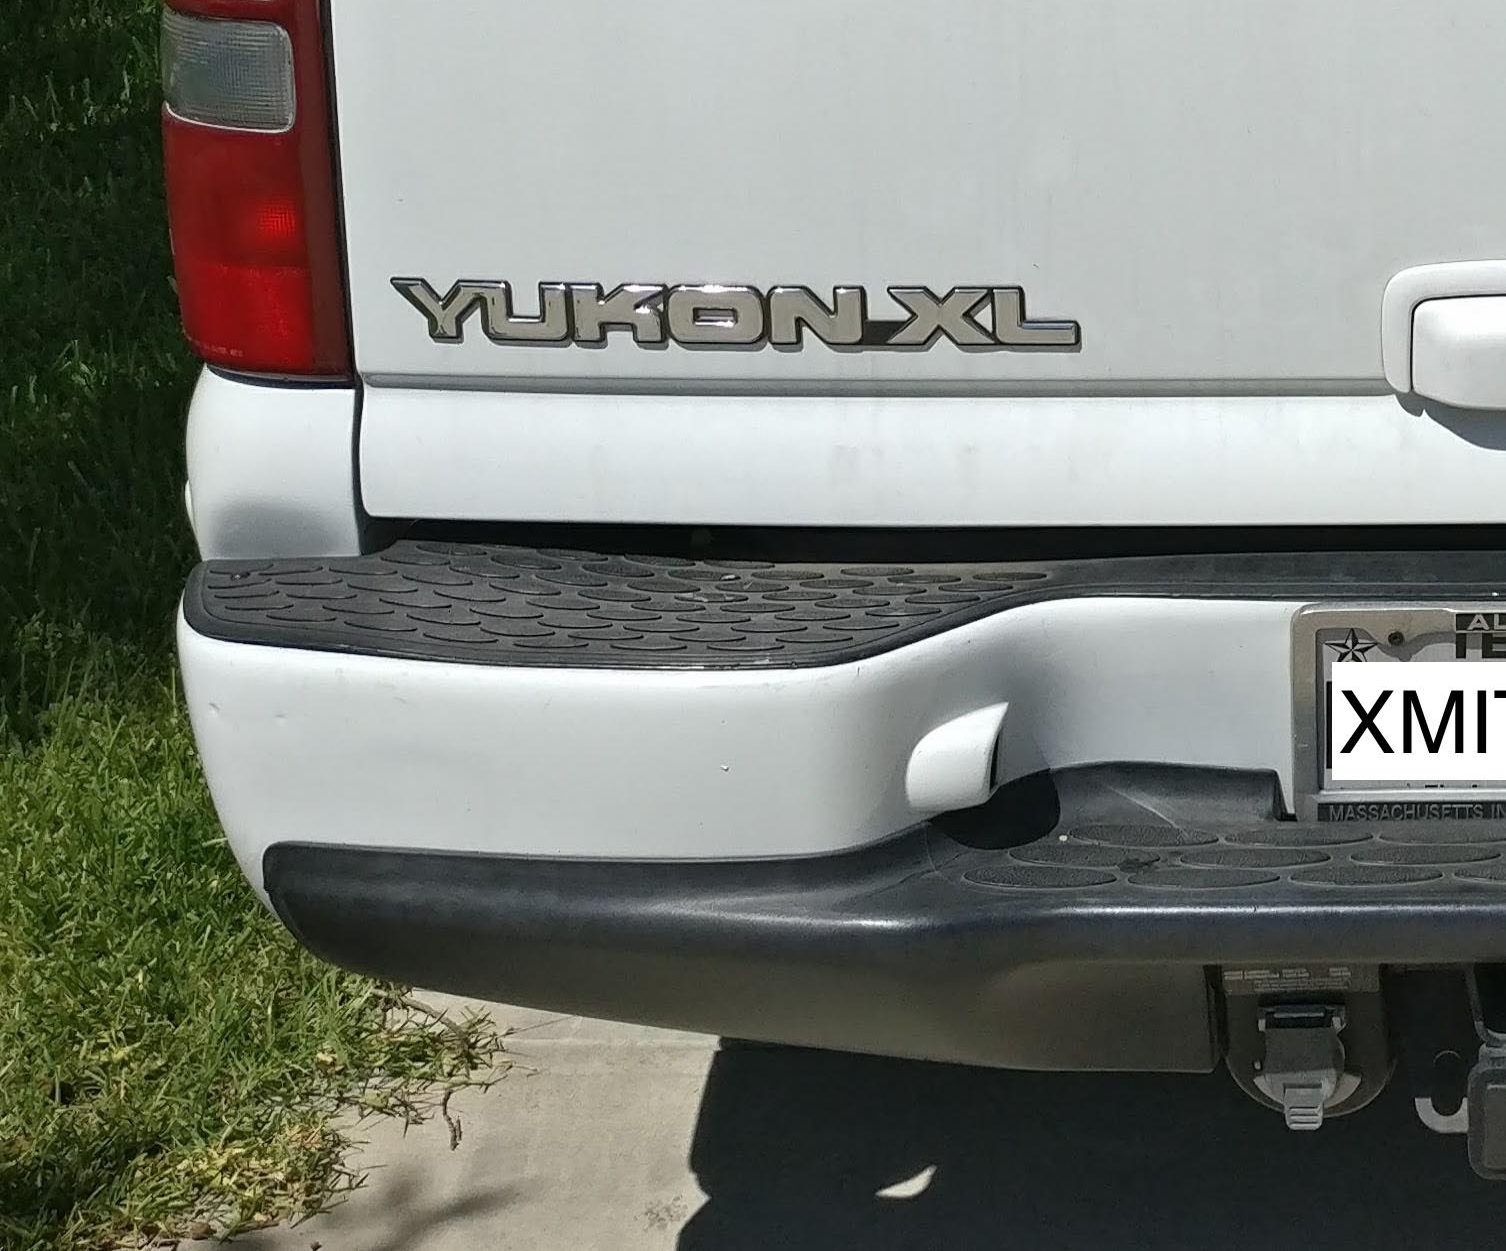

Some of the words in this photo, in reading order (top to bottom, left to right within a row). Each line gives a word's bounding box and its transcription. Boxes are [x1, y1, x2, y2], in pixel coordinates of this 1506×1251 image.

[390, 277, 866, 348] YUKON
[887, 286, 1081, 349] XL
[1329, 803, 1484, 821] MASSACHUSETTS
